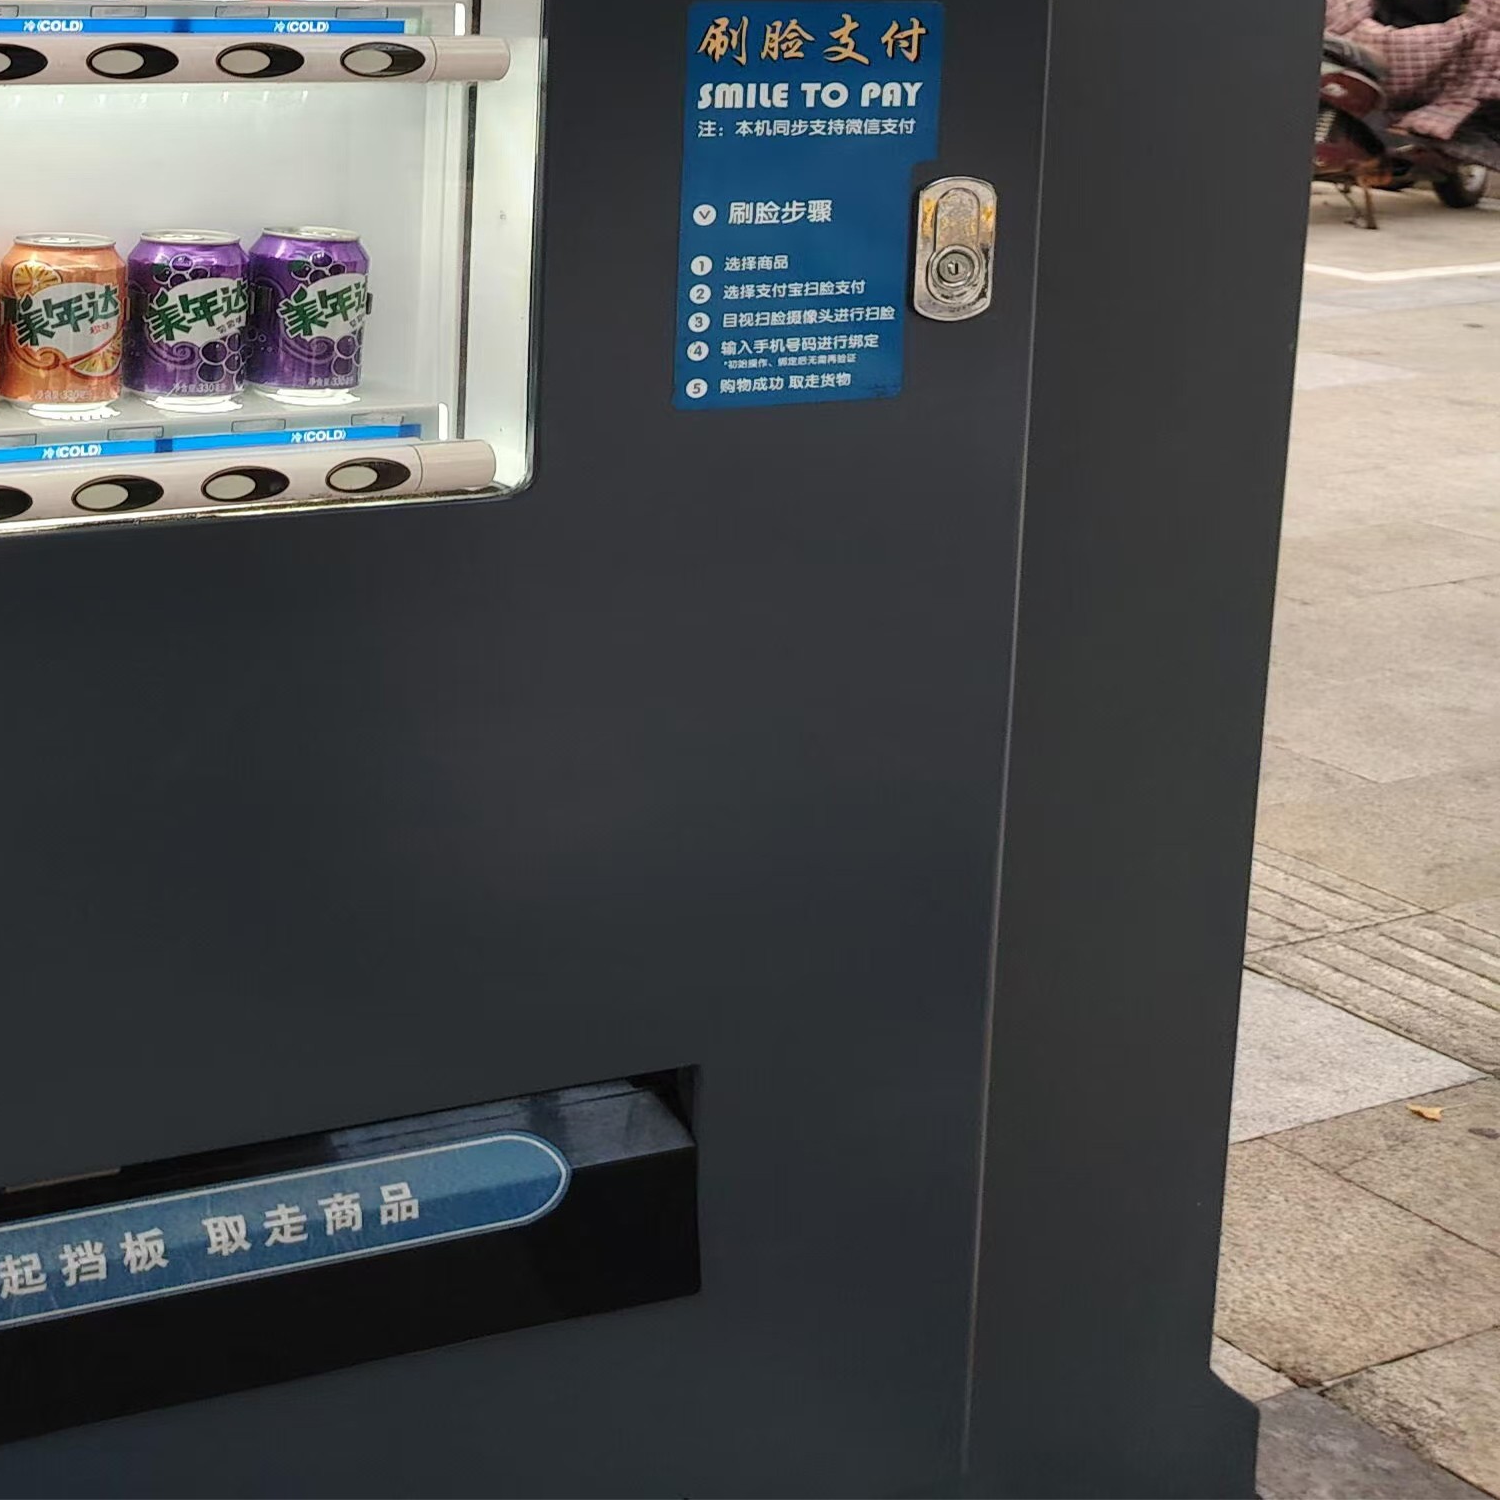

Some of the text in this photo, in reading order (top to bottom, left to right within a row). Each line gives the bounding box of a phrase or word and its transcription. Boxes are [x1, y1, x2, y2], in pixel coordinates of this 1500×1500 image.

[697, 14, 927, 67] 刷脸支付
[697, 81, 924, 110] SMILE TO PAY
[728, 199, 833, 225] 刷脸步骤
[724, 254, 789, 272] 选择商品
[723, 280, 866, 300] 选择支付宝扫脸支付
[16, 285, 120, 347] 美年达
[145, 280, 248, 341] 美年达
[722, 306, 895, 328] 目视扫脸摄像头进行扫脸
[721, 334, 879, 355] 输入手机号码进行绑定
[719, 375, 784, 394] 购物成功
[788, 372, 852, 389] 取走货物
[202, 1182, 420, 1258] 取走商品
